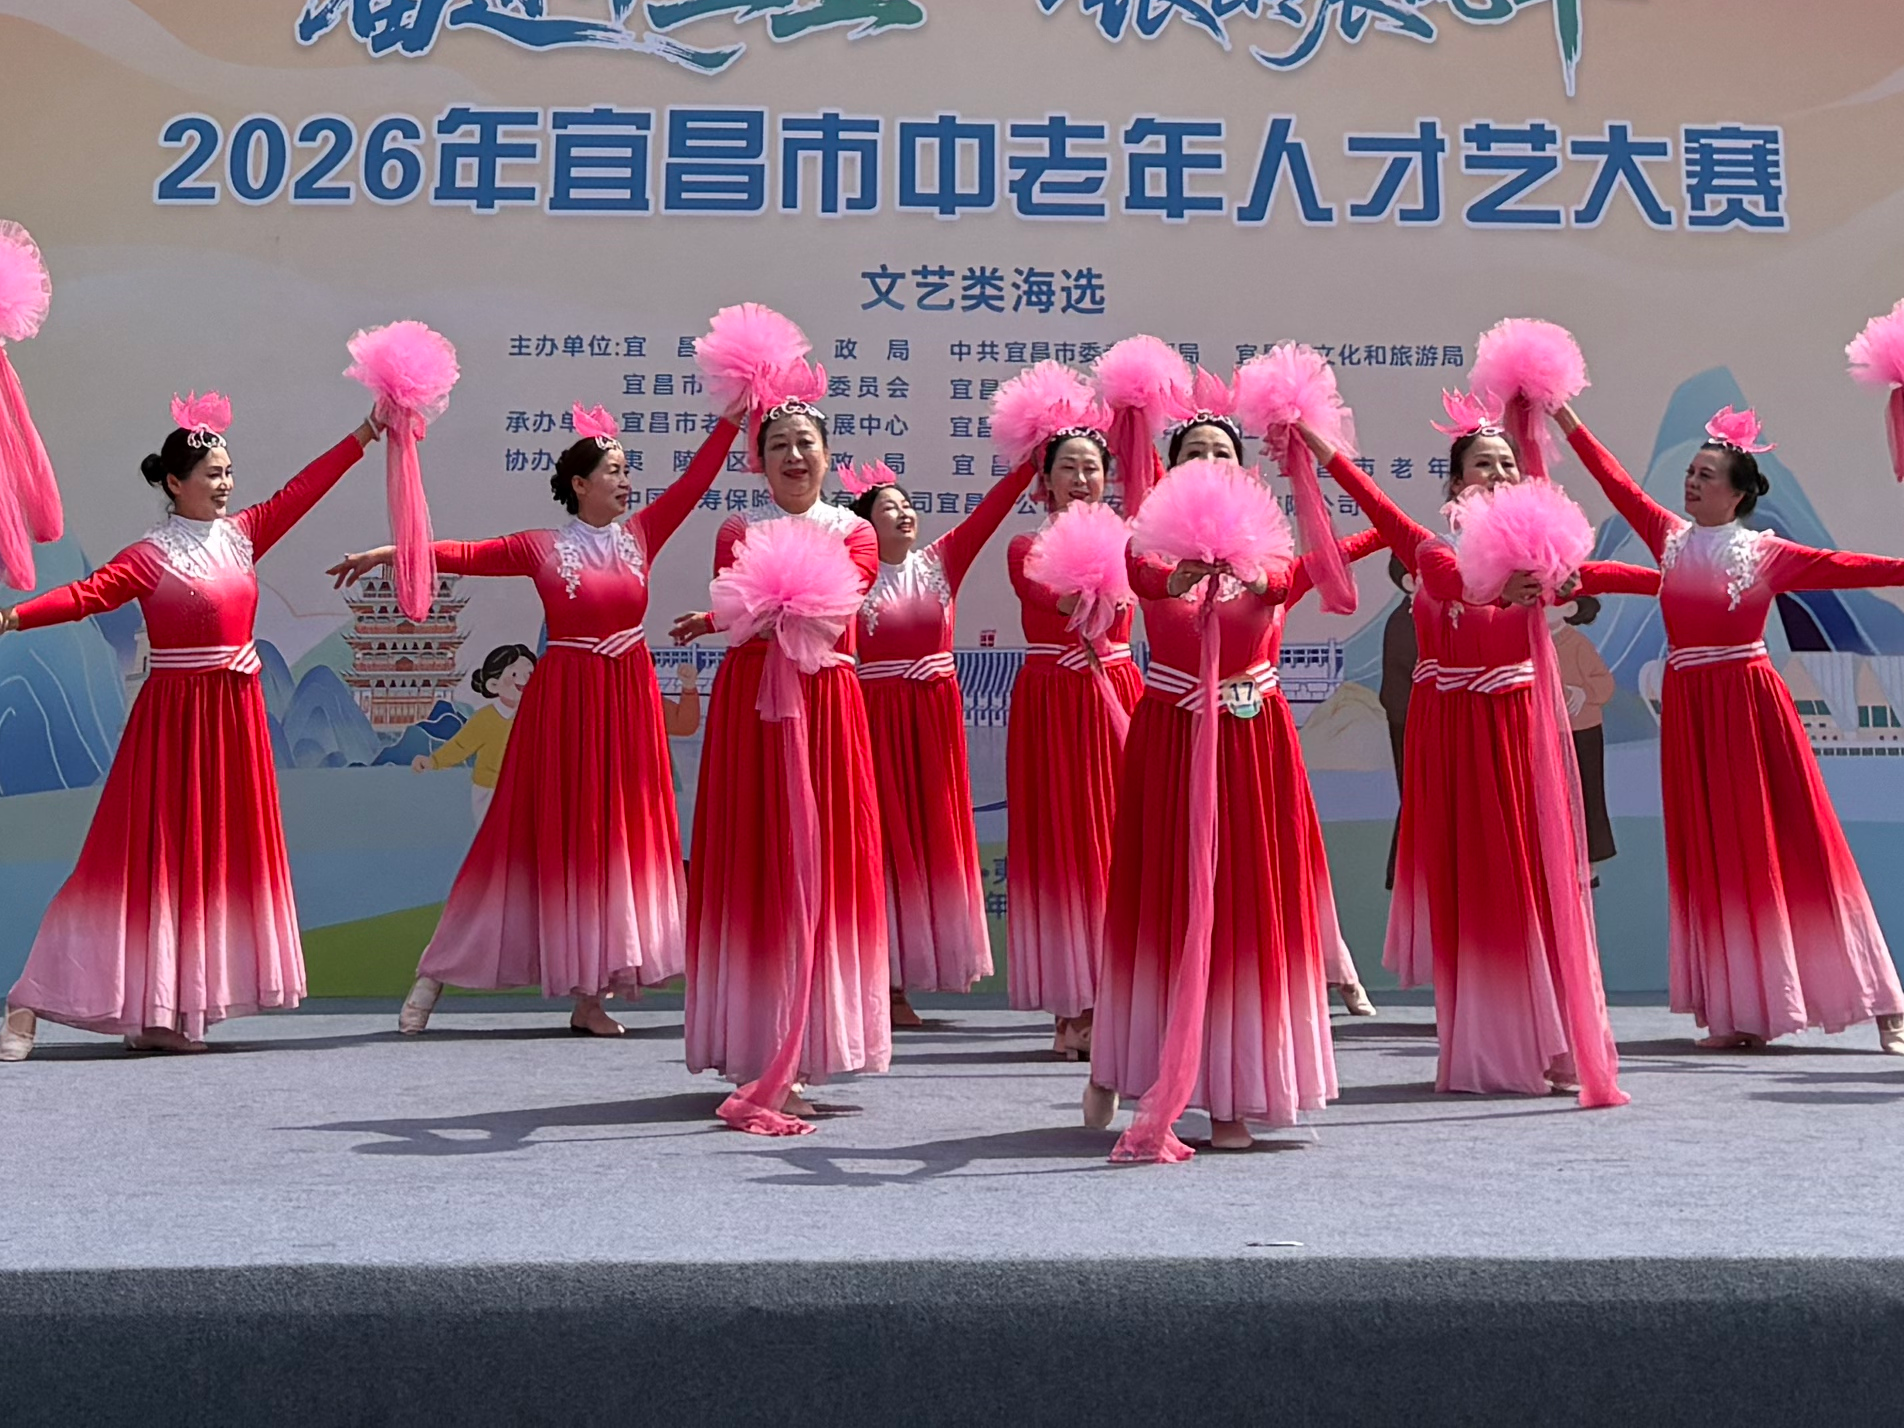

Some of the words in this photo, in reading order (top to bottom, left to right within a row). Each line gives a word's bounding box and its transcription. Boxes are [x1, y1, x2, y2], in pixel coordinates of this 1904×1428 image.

[154, 106, 1788, 230] 2026年宜昌市中老年人才艺大赛
[860, 263, 1106, 315] 文艺类海选
[1230, 681, 1253, 702] 17
